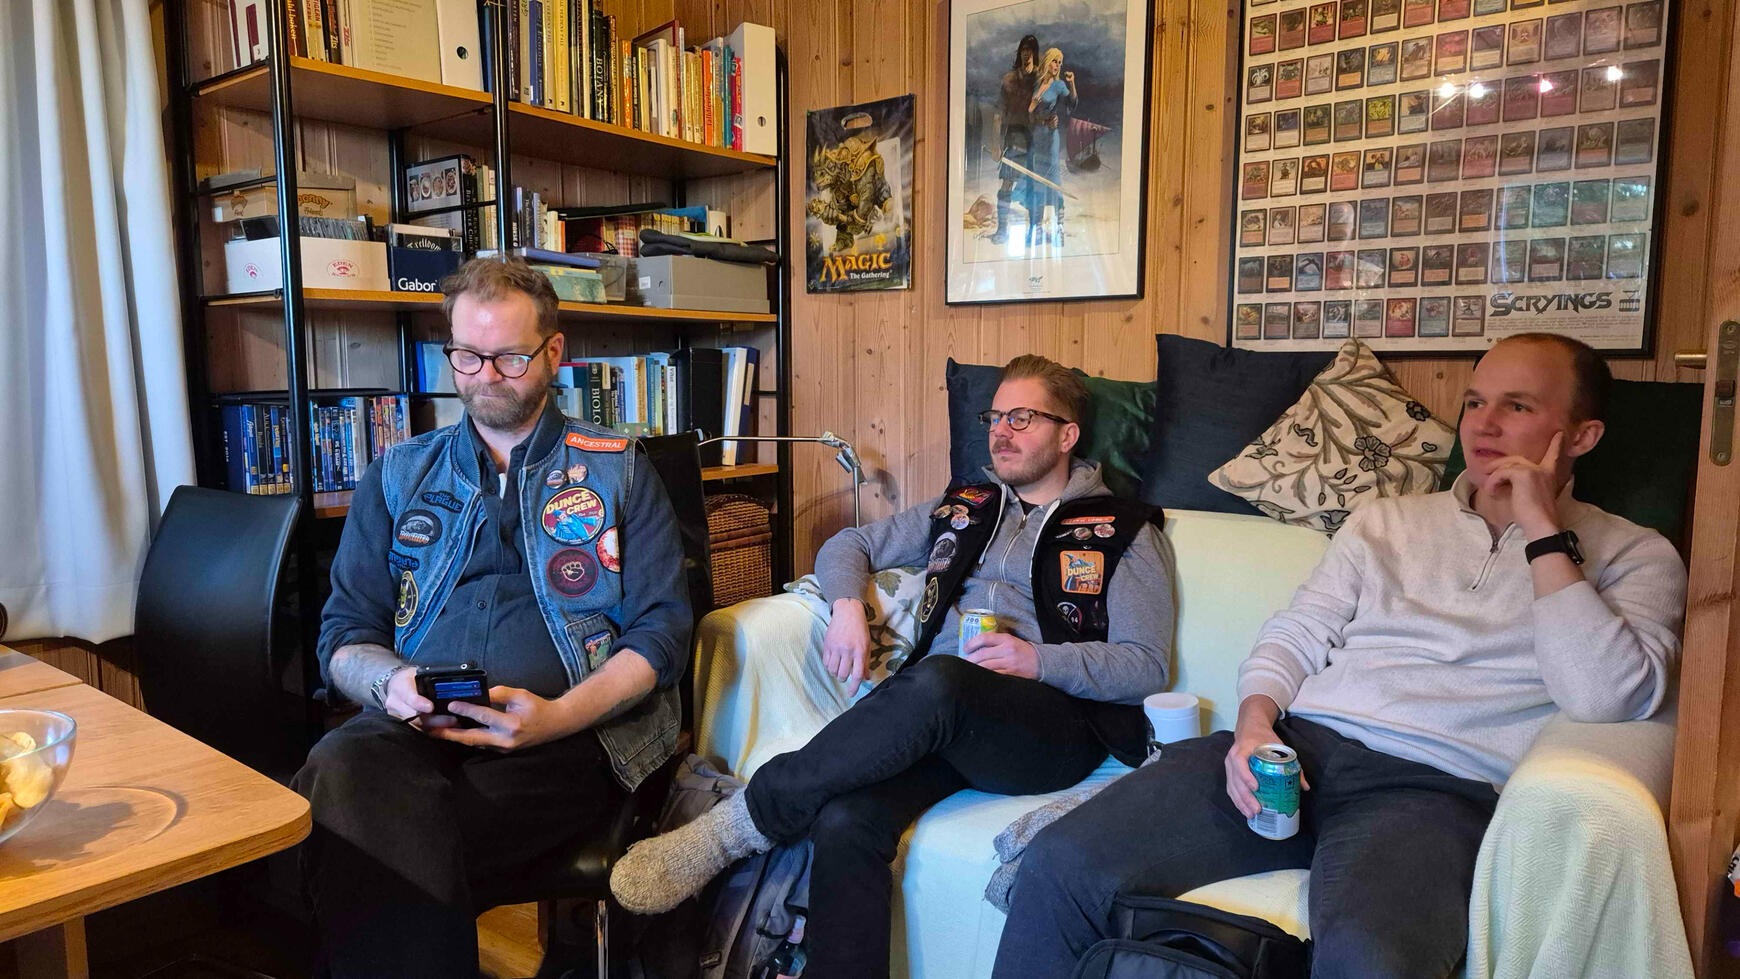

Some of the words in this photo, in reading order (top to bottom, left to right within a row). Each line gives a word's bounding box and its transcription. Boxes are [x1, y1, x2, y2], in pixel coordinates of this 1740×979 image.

[333, 261, 353, 269] EDEN
[819, 252, 893, 284] MAGIC
[849, 272, 861, 280] The
[861, 270, 890, 279] Gathering
[397, 277, 437, 292] Gabor
[1489, 291, 1613, 317] SCRYINGS
[570, 436, 622, 448] ANCESTRAL
[546, 490, 592, 514] DUNCE
[566, 499, 597, 515] CREW
[1066, 566, 1097, 577] DUNCE
